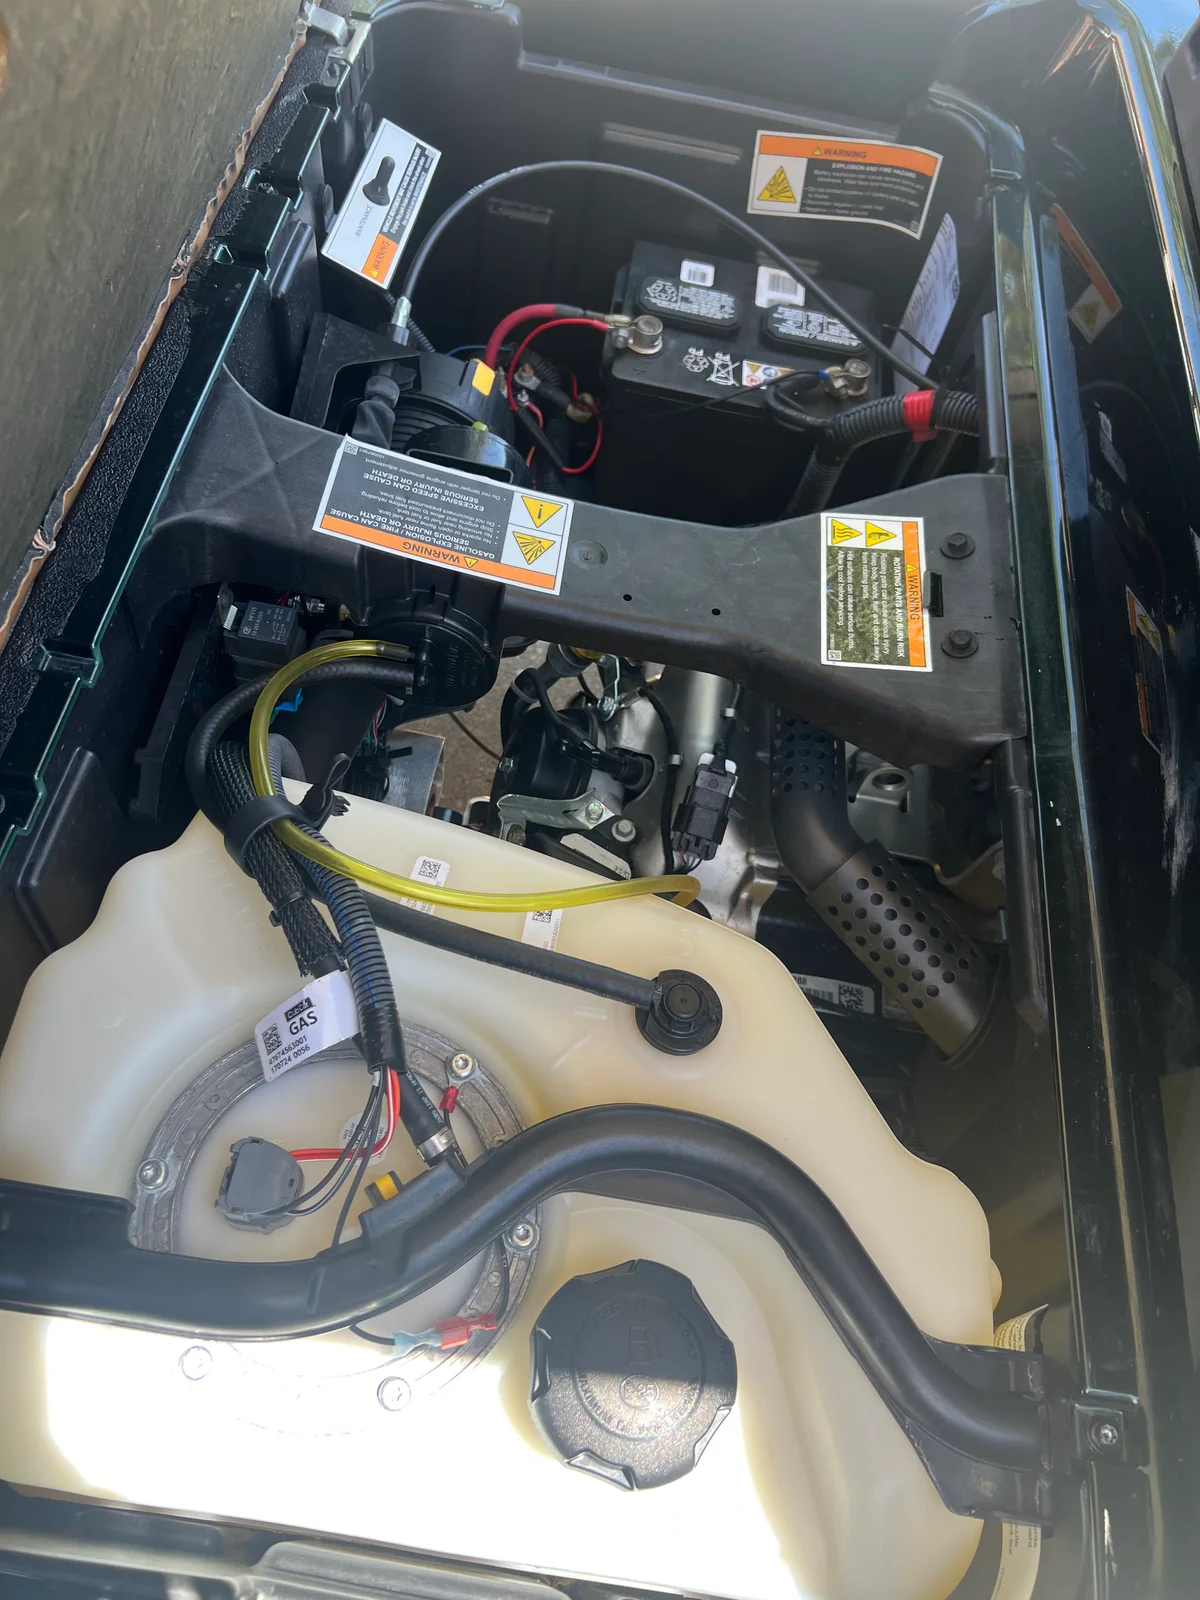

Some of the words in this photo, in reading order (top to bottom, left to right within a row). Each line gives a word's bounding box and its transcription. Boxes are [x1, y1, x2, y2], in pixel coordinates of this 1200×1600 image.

[824, 148, 866, 157] WARNING
[892, 169, 916, 178] HAZARD
[354, 203, 373, 237] MAINTENANCE
[372, 240, 390, 270] WARNING
[362, 472, 391, 485] CAUSE
[371, 468, 398, 480] DEATH
[398, 467, 424, 478] governor
[392, 481, 410, 490] CAN
[399, 477, 412, 485] OR
[425, 475, 445, 484] engine
[411, 487, 438, 499] SPEED
[413, 481, 442, 493] INJURY
[459, 484, 480, 494] tamper
[444, 489, 479, 503] SERIOUS
[388, 499, 407, 508] before
[407, 498, 441, 512] pressurized
[440, 495, 484, 511] EXCESSIVE
[329, 508, 359, 521] CAUSE
[359, 510, 387, 522] DEATH
[429, 511, 444, 519] allow
[442, 508, 474, 521] disconnect
[360, 517, 378, 526] CAN
[379, 523, 399, 532] FIRE
[419, 520, 436, 529] flame
[458, 518, 479, 528] engine
[403, 523, 432, 535] INJURY
[437, 524, 452, 532] open
[457, 523, 482, 535] smoking
[479, 524, 493, 532] Stop
[404, 530, 451, 547] EXPLOSION
[433, 531, 469, 546] SERIOUS
[461, 531, 481, 541] sparks
[402, 541, 460, 563] WARNING
[453, 543, 494, 559] GASOLINE
[878, 553, 887, 574] Rotating
[846, 561, 854, 582] surfaces
[860, 564, 869, 584] rotating
[893, 557, 901, 586] ROTATING
[879, 575, 887, 588] parts
[894, 587, 902, 607] PARTS
[908, 575, 919, 620] WARNING
[872, 646, 880, 661] away
[287, 1011, 318, 1035] GAS
[269, 1055, 293, 1073] 170724
[292, 1044, 311, 1058] 0056
